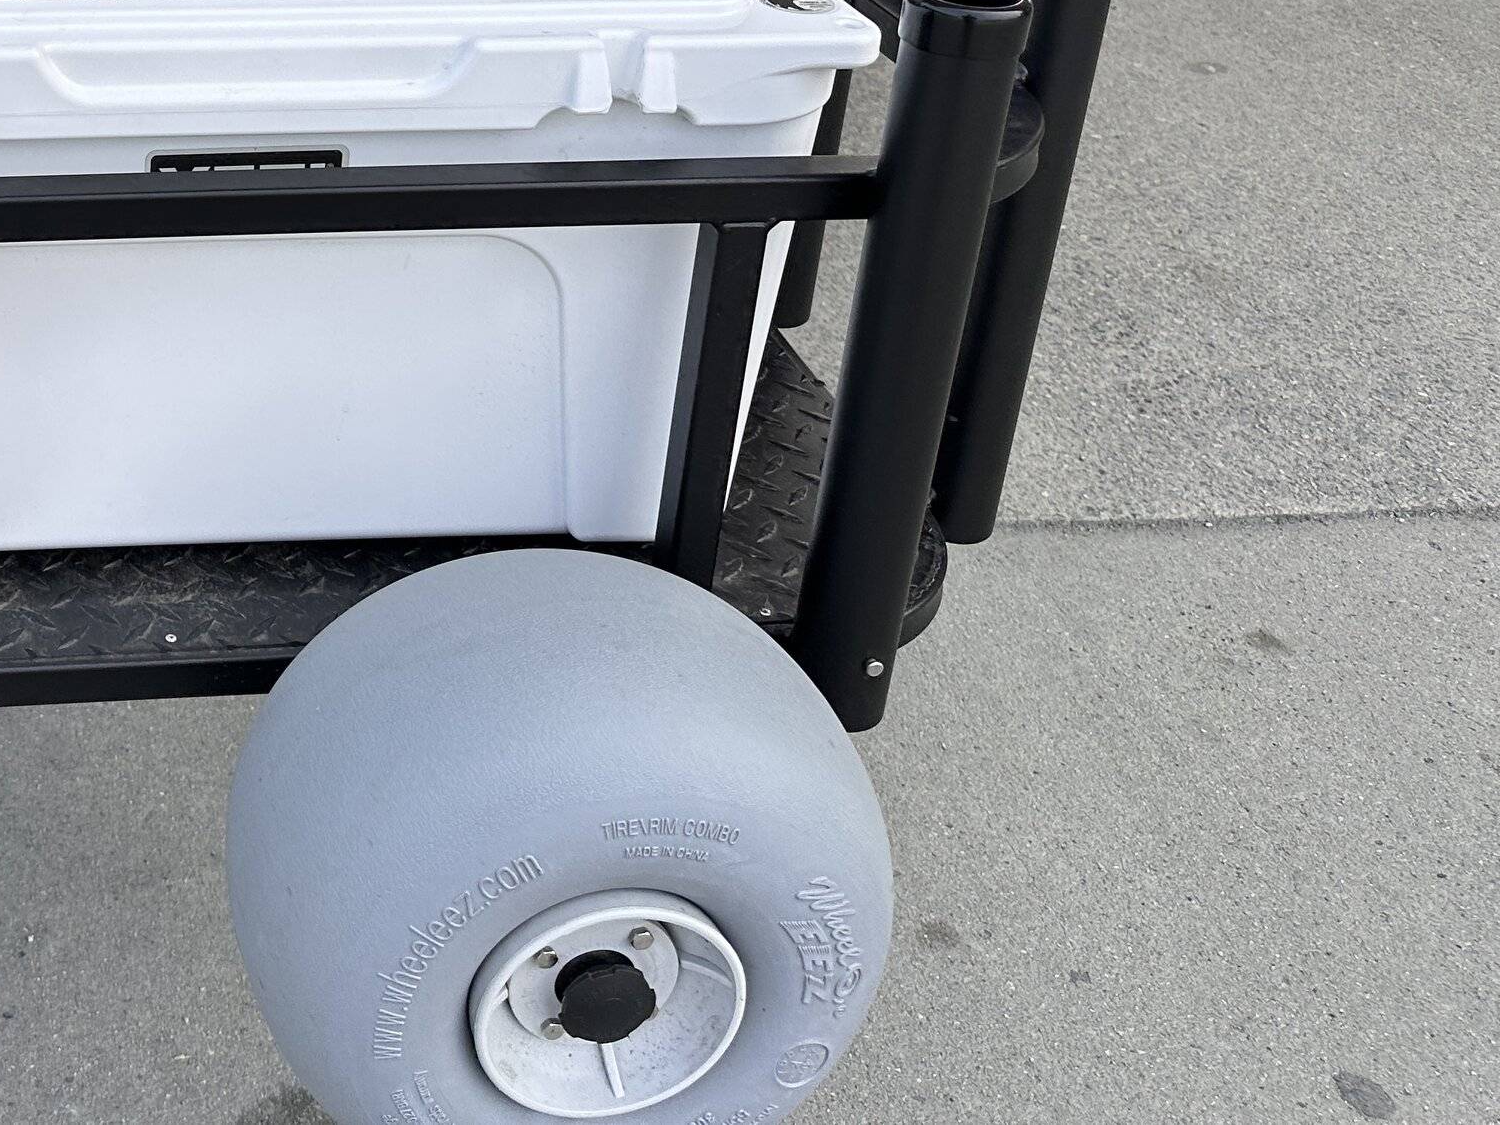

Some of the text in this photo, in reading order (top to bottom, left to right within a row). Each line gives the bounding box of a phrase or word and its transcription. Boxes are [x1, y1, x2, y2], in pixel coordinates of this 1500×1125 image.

[683, 819, 741, 846] COMBO
[625, 845, 710, 863] MADE IN CHINA
[373, 854, 544, 1060] www.wheeleez.com
